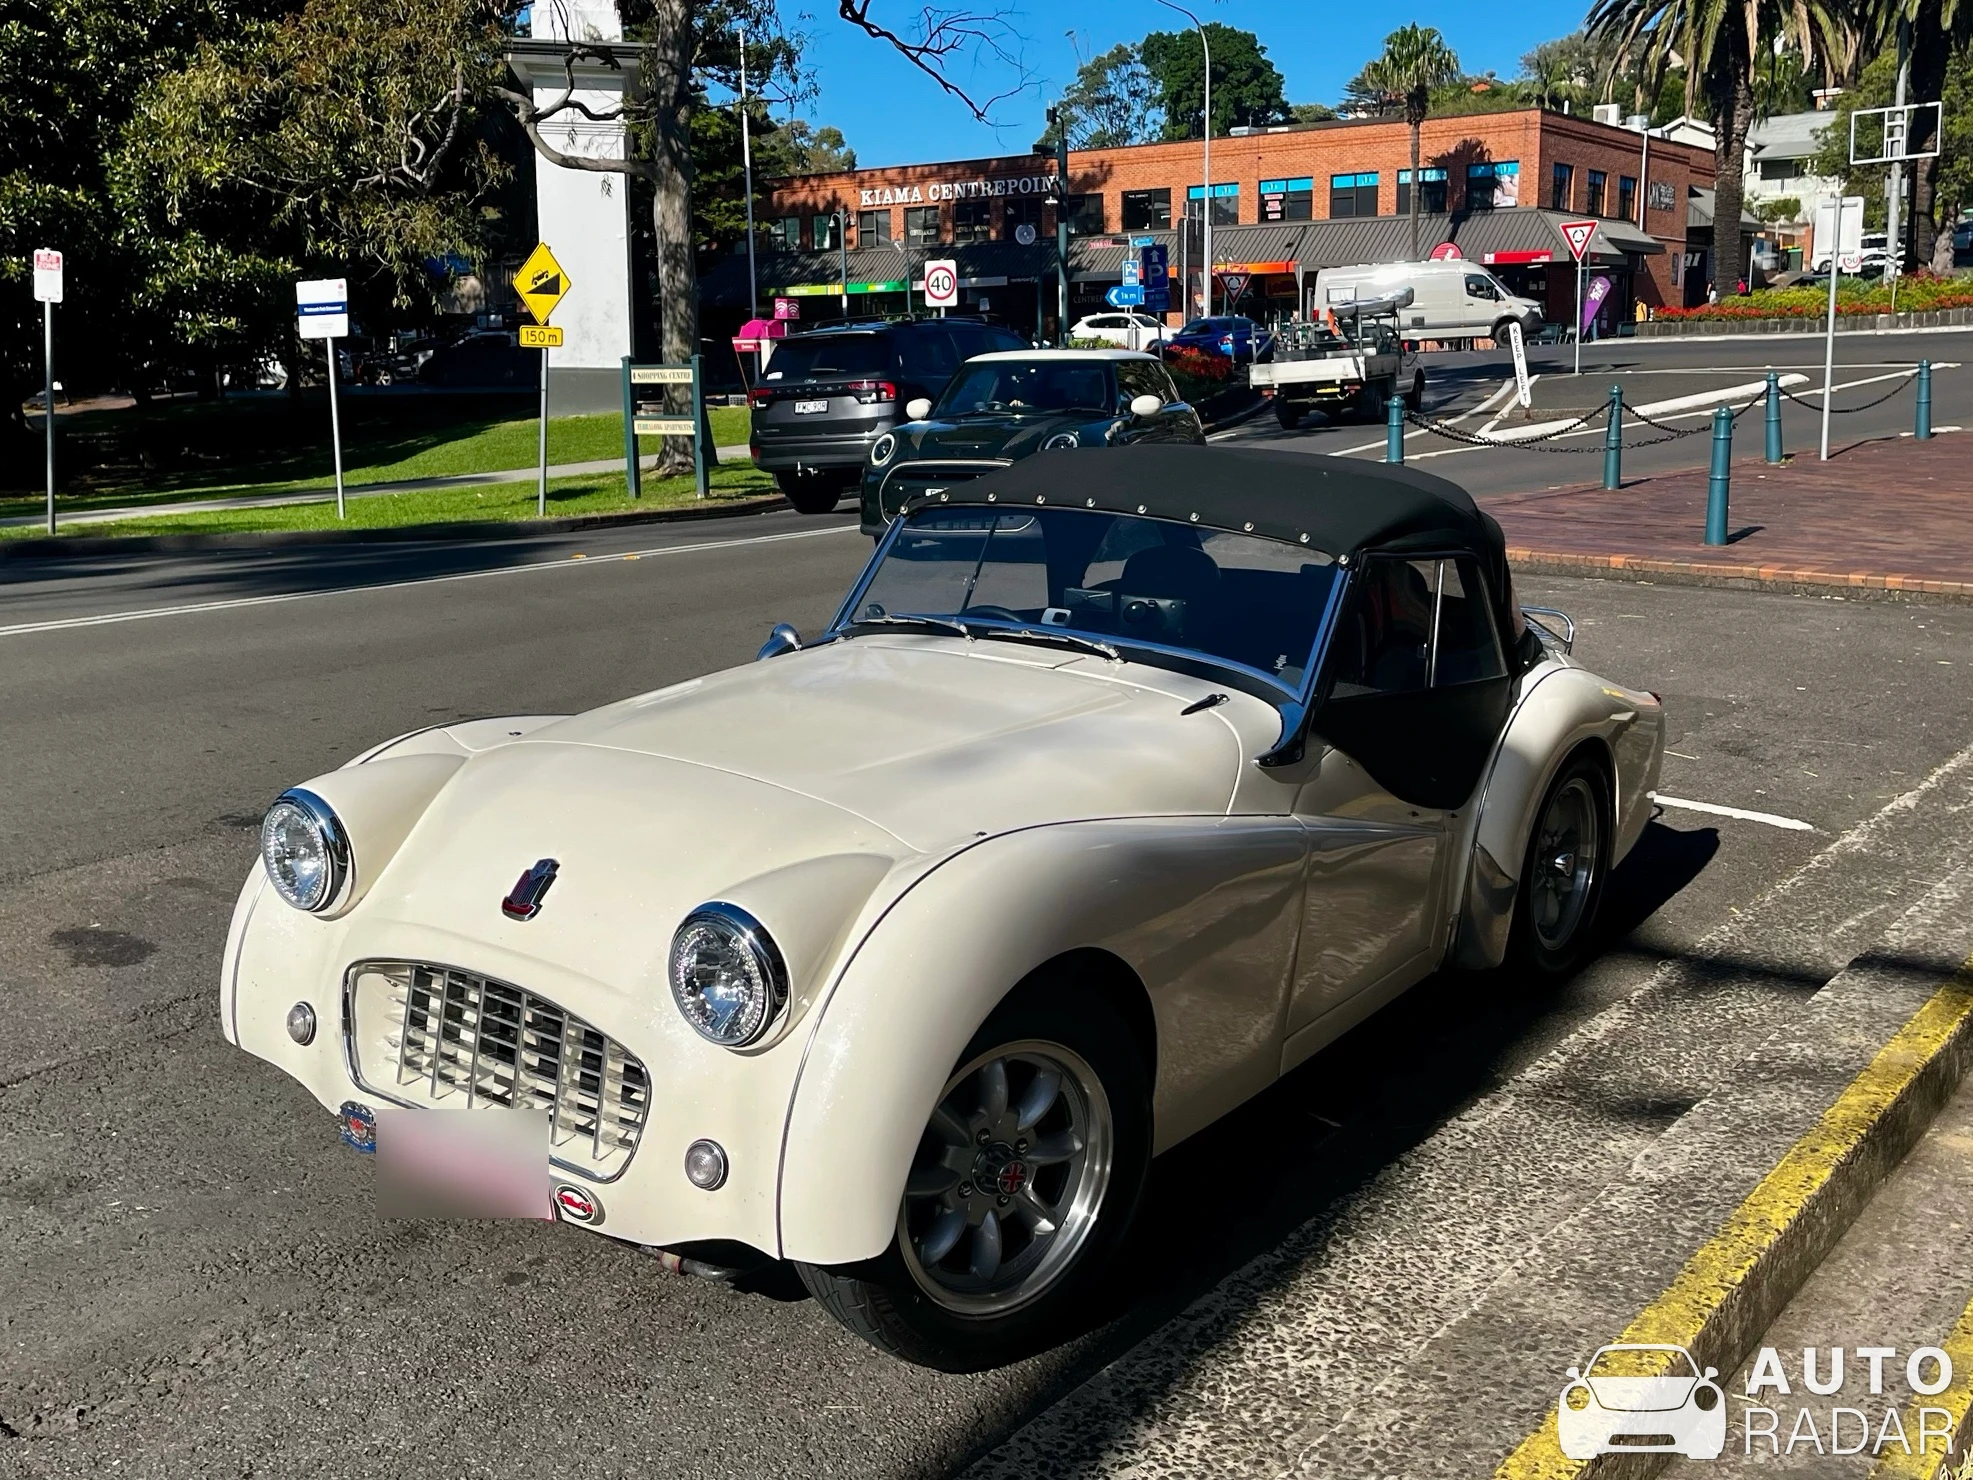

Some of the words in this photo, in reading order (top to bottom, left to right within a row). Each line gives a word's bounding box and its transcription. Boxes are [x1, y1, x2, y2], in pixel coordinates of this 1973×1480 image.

[860, 184, 923, 206] KIAMA
[1147, 264, 1164, 285] P
[930, 275, 952, 291] 40
[1073, 294, 1104, 304] CENTREP
[525, 330, 546, 343] 150
[548, 334, 558, 343] m
[1512, 325, 1523, 359] KEEP
[1518, 367, 1528, 402] LEFT
[637, 371, 668, 380] SHOPPING
[669, 371, 691, 379] CENTRE
[664, 423, 692, 431] APARTMENTS
